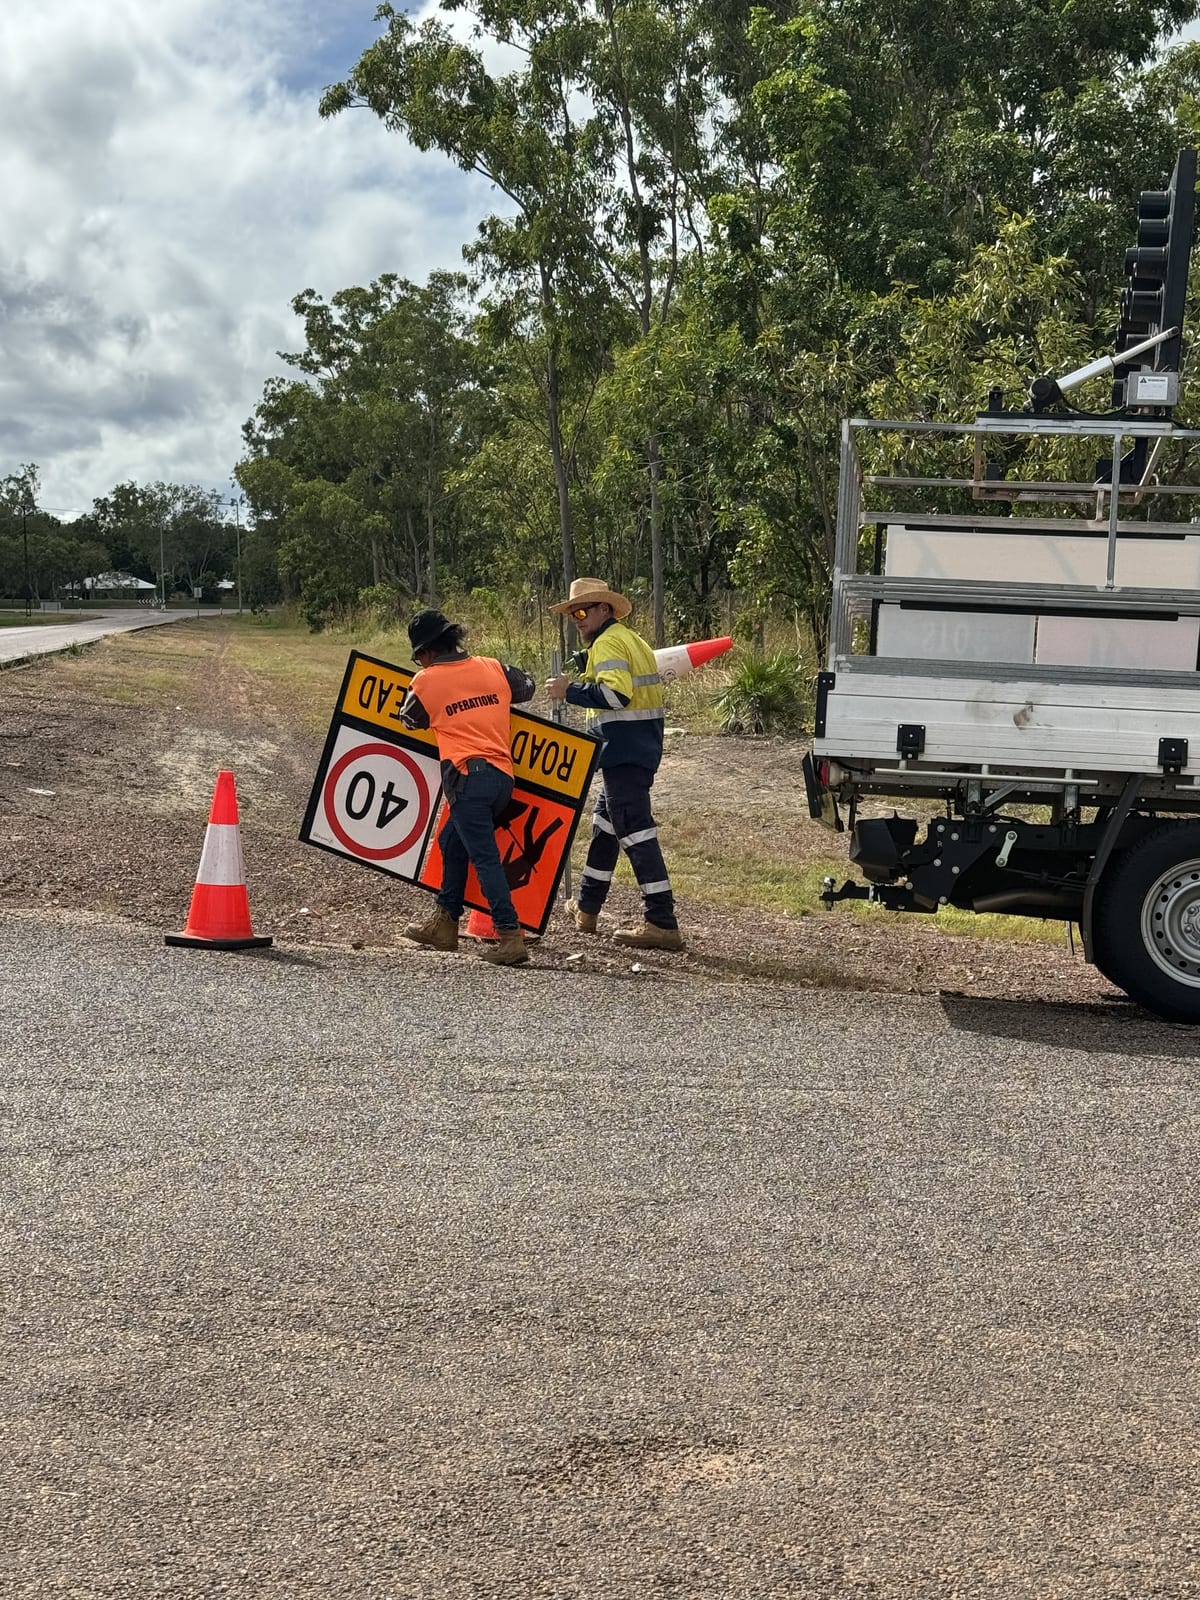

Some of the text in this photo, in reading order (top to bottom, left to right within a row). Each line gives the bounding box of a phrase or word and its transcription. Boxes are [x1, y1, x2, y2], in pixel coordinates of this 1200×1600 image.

[359, 674, 577, 783] ROAD EAD
[445, 694, 500, 717] OPERATIONS
[345, 770, 408, 829] 40
